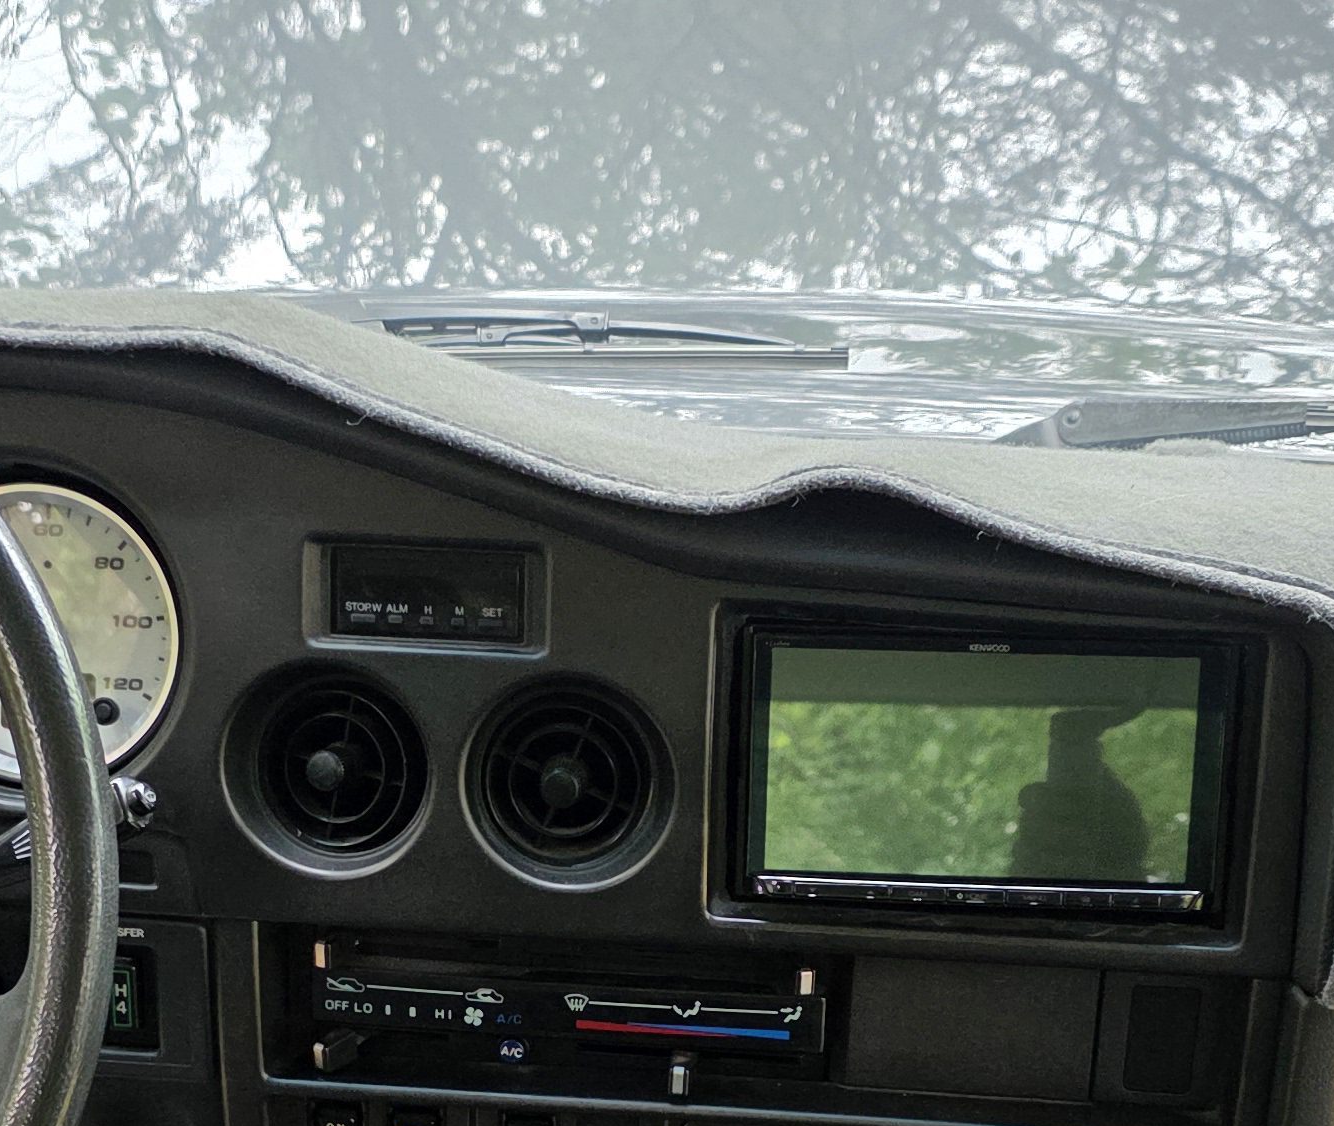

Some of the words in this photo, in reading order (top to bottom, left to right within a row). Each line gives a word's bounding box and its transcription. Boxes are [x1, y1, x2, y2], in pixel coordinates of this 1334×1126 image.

[33, 523, 64, 537] 60
[94, 556, 126, 571] 80
[385, 603, 409, 614] ALM
[423, 605, 433, 615] H
[454, 605, 465, 616] M
[481, 607, 504, 618] SET
[112, 614, 154, 630] 100
[969, 643, 1011, 653] KENWOOD
[102, 676, 144, 692] 120
[324, 999, 350, 1011] OFF
[353, 1002, 374, 1014] LO
[434, 1008, 453, 1020] HI
[495, 1013, 523, 1025] A/C
[500, 1046, 524, 1058] A/C
